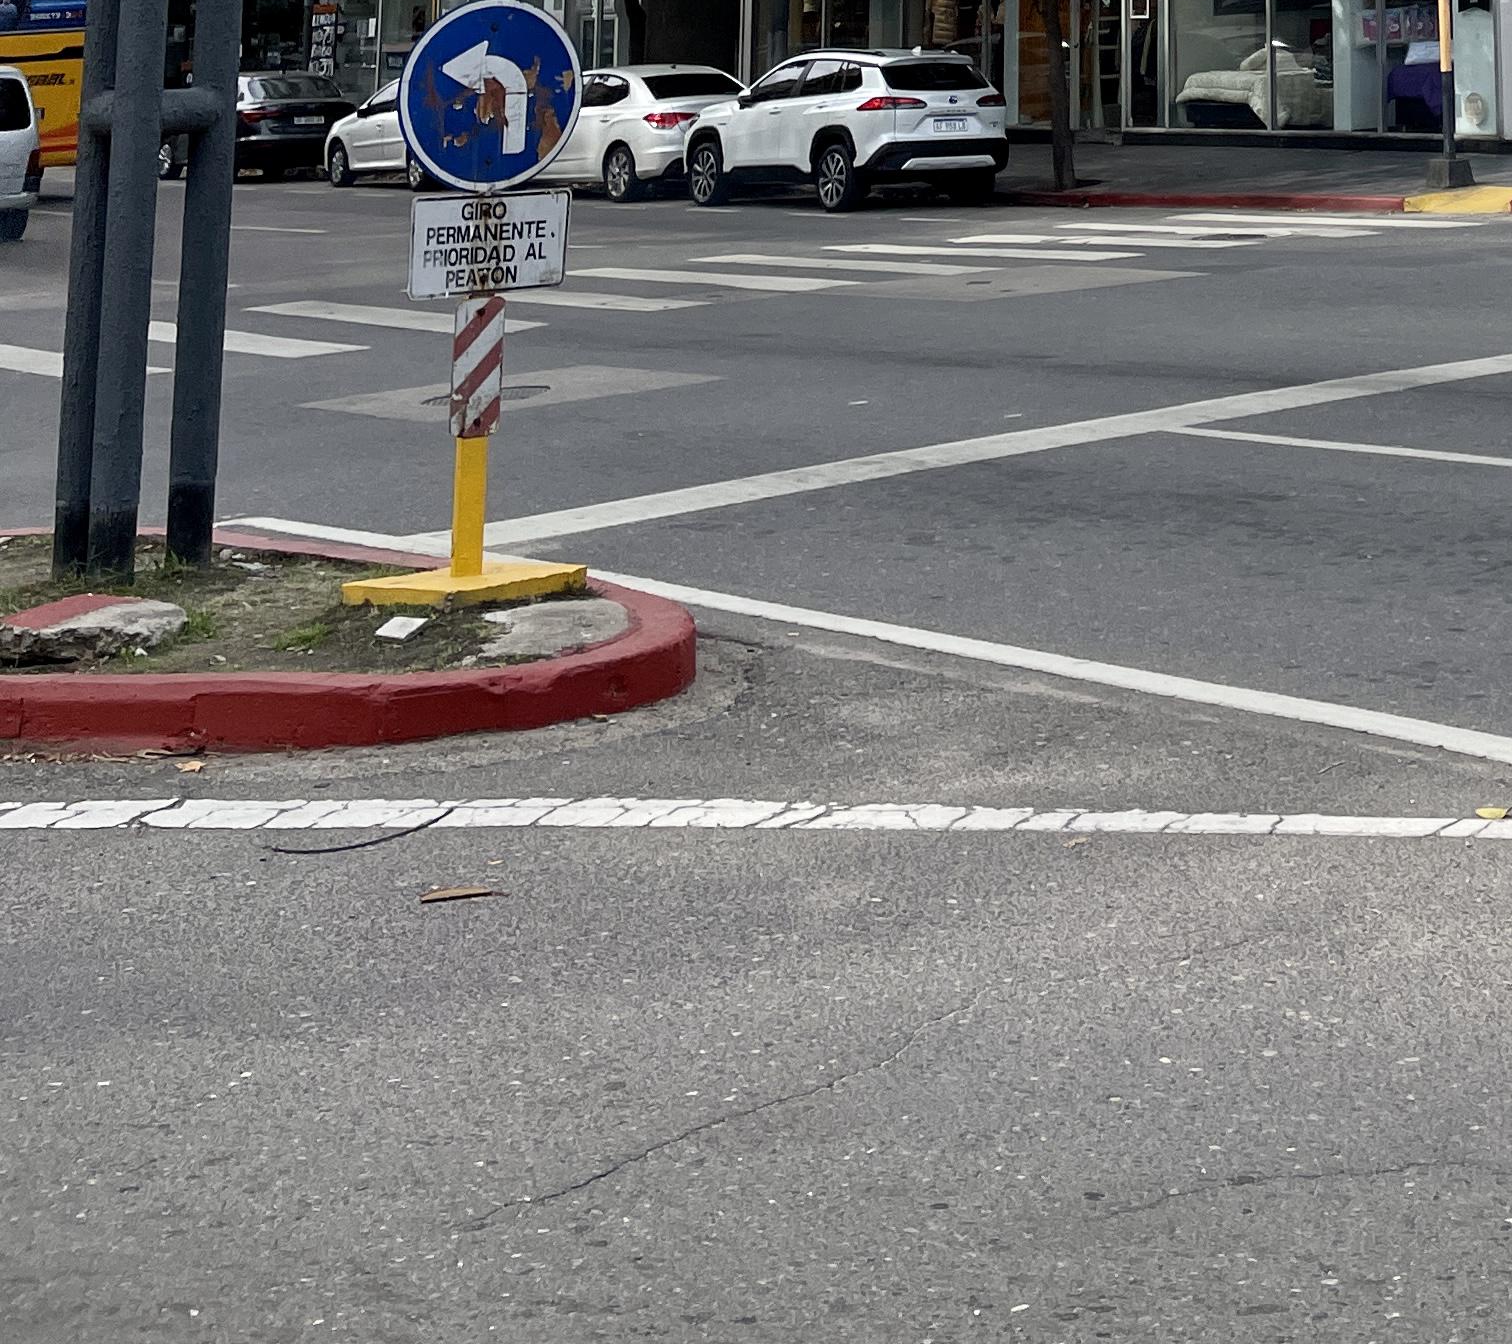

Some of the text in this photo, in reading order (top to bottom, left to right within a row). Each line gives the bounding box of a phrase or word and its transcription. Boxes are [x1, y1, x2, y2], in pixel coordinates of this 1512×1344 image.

[461, 201, 508, 221] GIRO
[423, 242, 547, 269] PRIORIDAD AL
